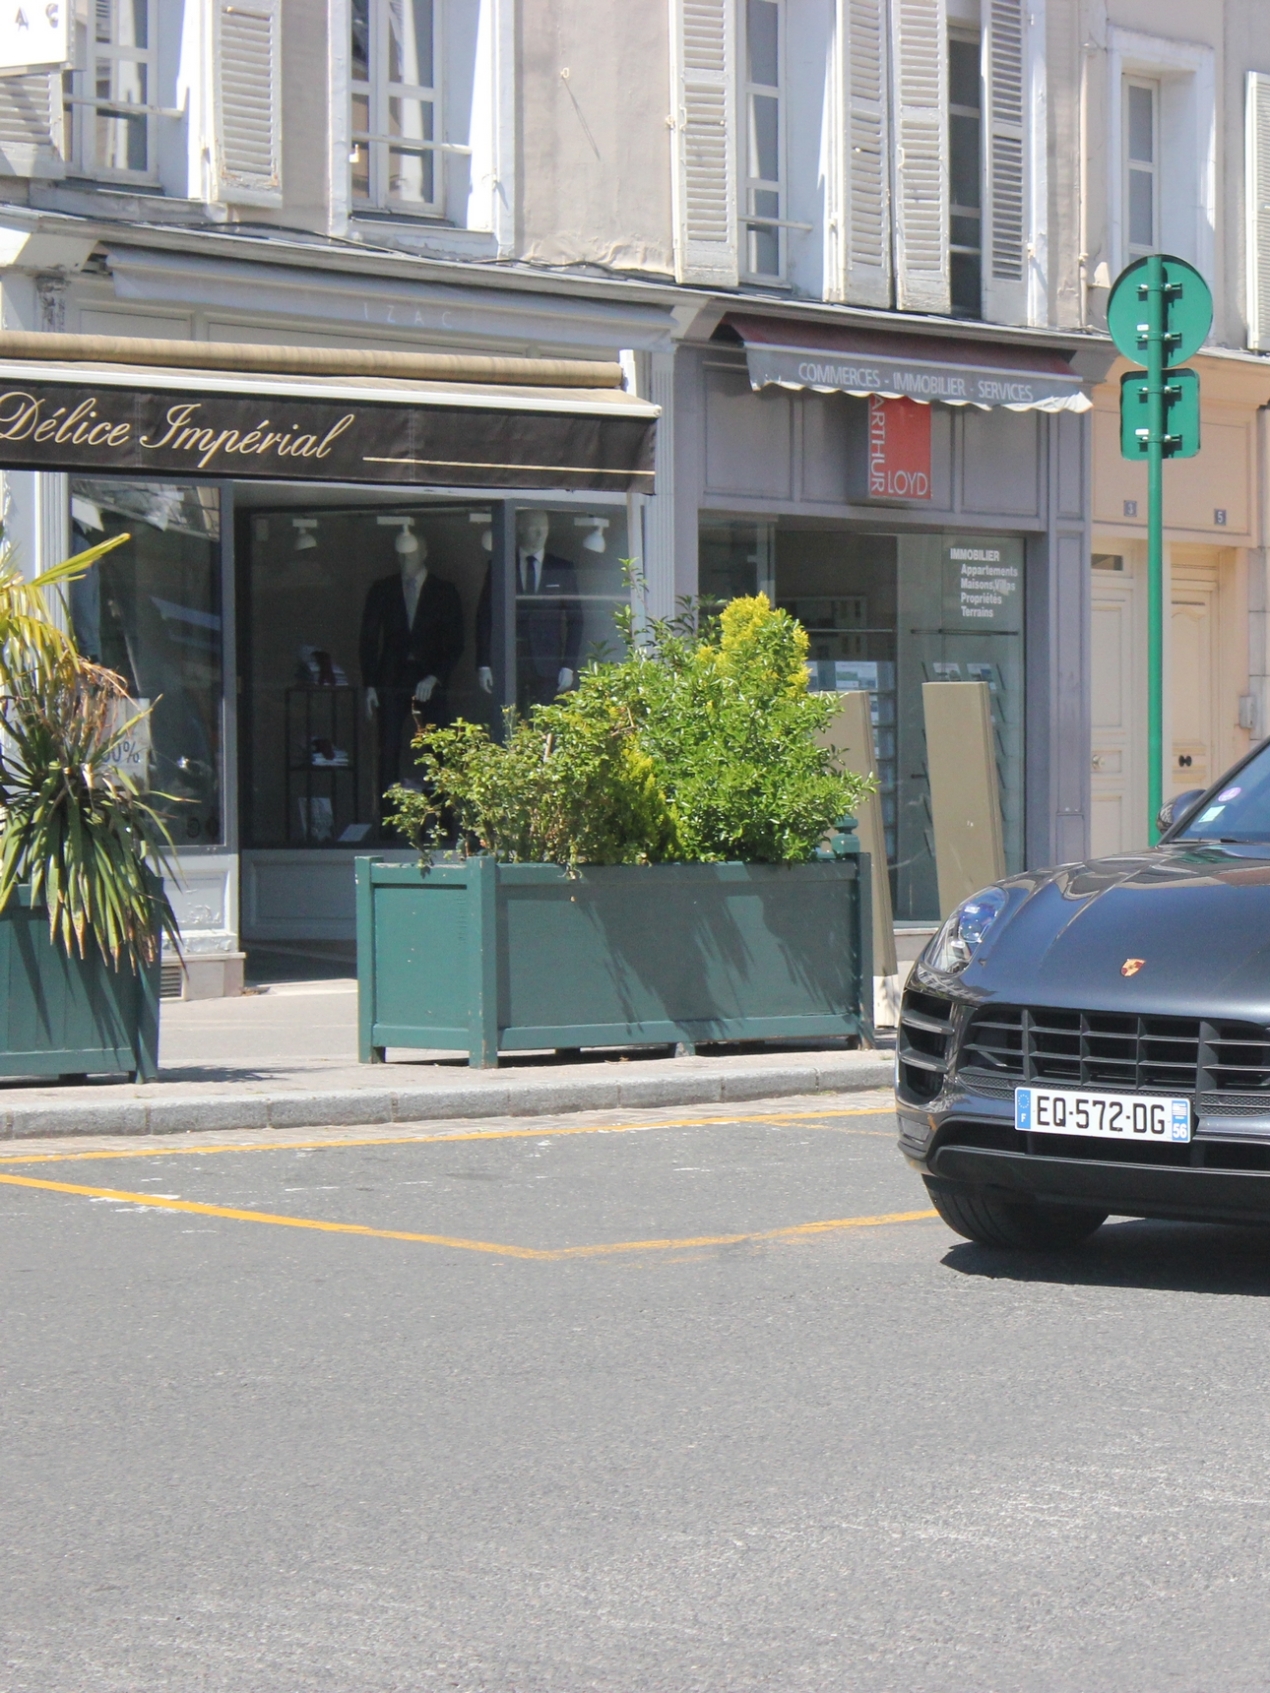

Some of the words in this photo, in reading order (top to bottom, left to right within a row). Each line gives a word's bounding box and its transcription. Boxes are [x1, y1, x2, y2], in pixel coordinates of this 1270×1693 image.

[363, 302, 453, 329] IZAC
[798, 362, 881, 388] COMMERCES
[893, 372, 966, 396] IMMOBILIER
[978, 381, 1034, 401] SERVICES
[0, 391, 131, 446] Délice
[139, 398, 354, 468] Impérial
[871, 393, 886, 492] ARTHUR
[887, 470, 929, 495] LOYD
[950, 547, 1000, 561] IMMOBILIER
[961, 563, 1018, 577] Appartements
[961, 591, 1002, 605] Propriétés
[961, 605, 994, 617] Terrains
[1021, 1113, 1026, 1122] F
[1037, 1095, 1165, 1134] EQ-572-DG
[1172, 1123, 1187, 1139] 56
